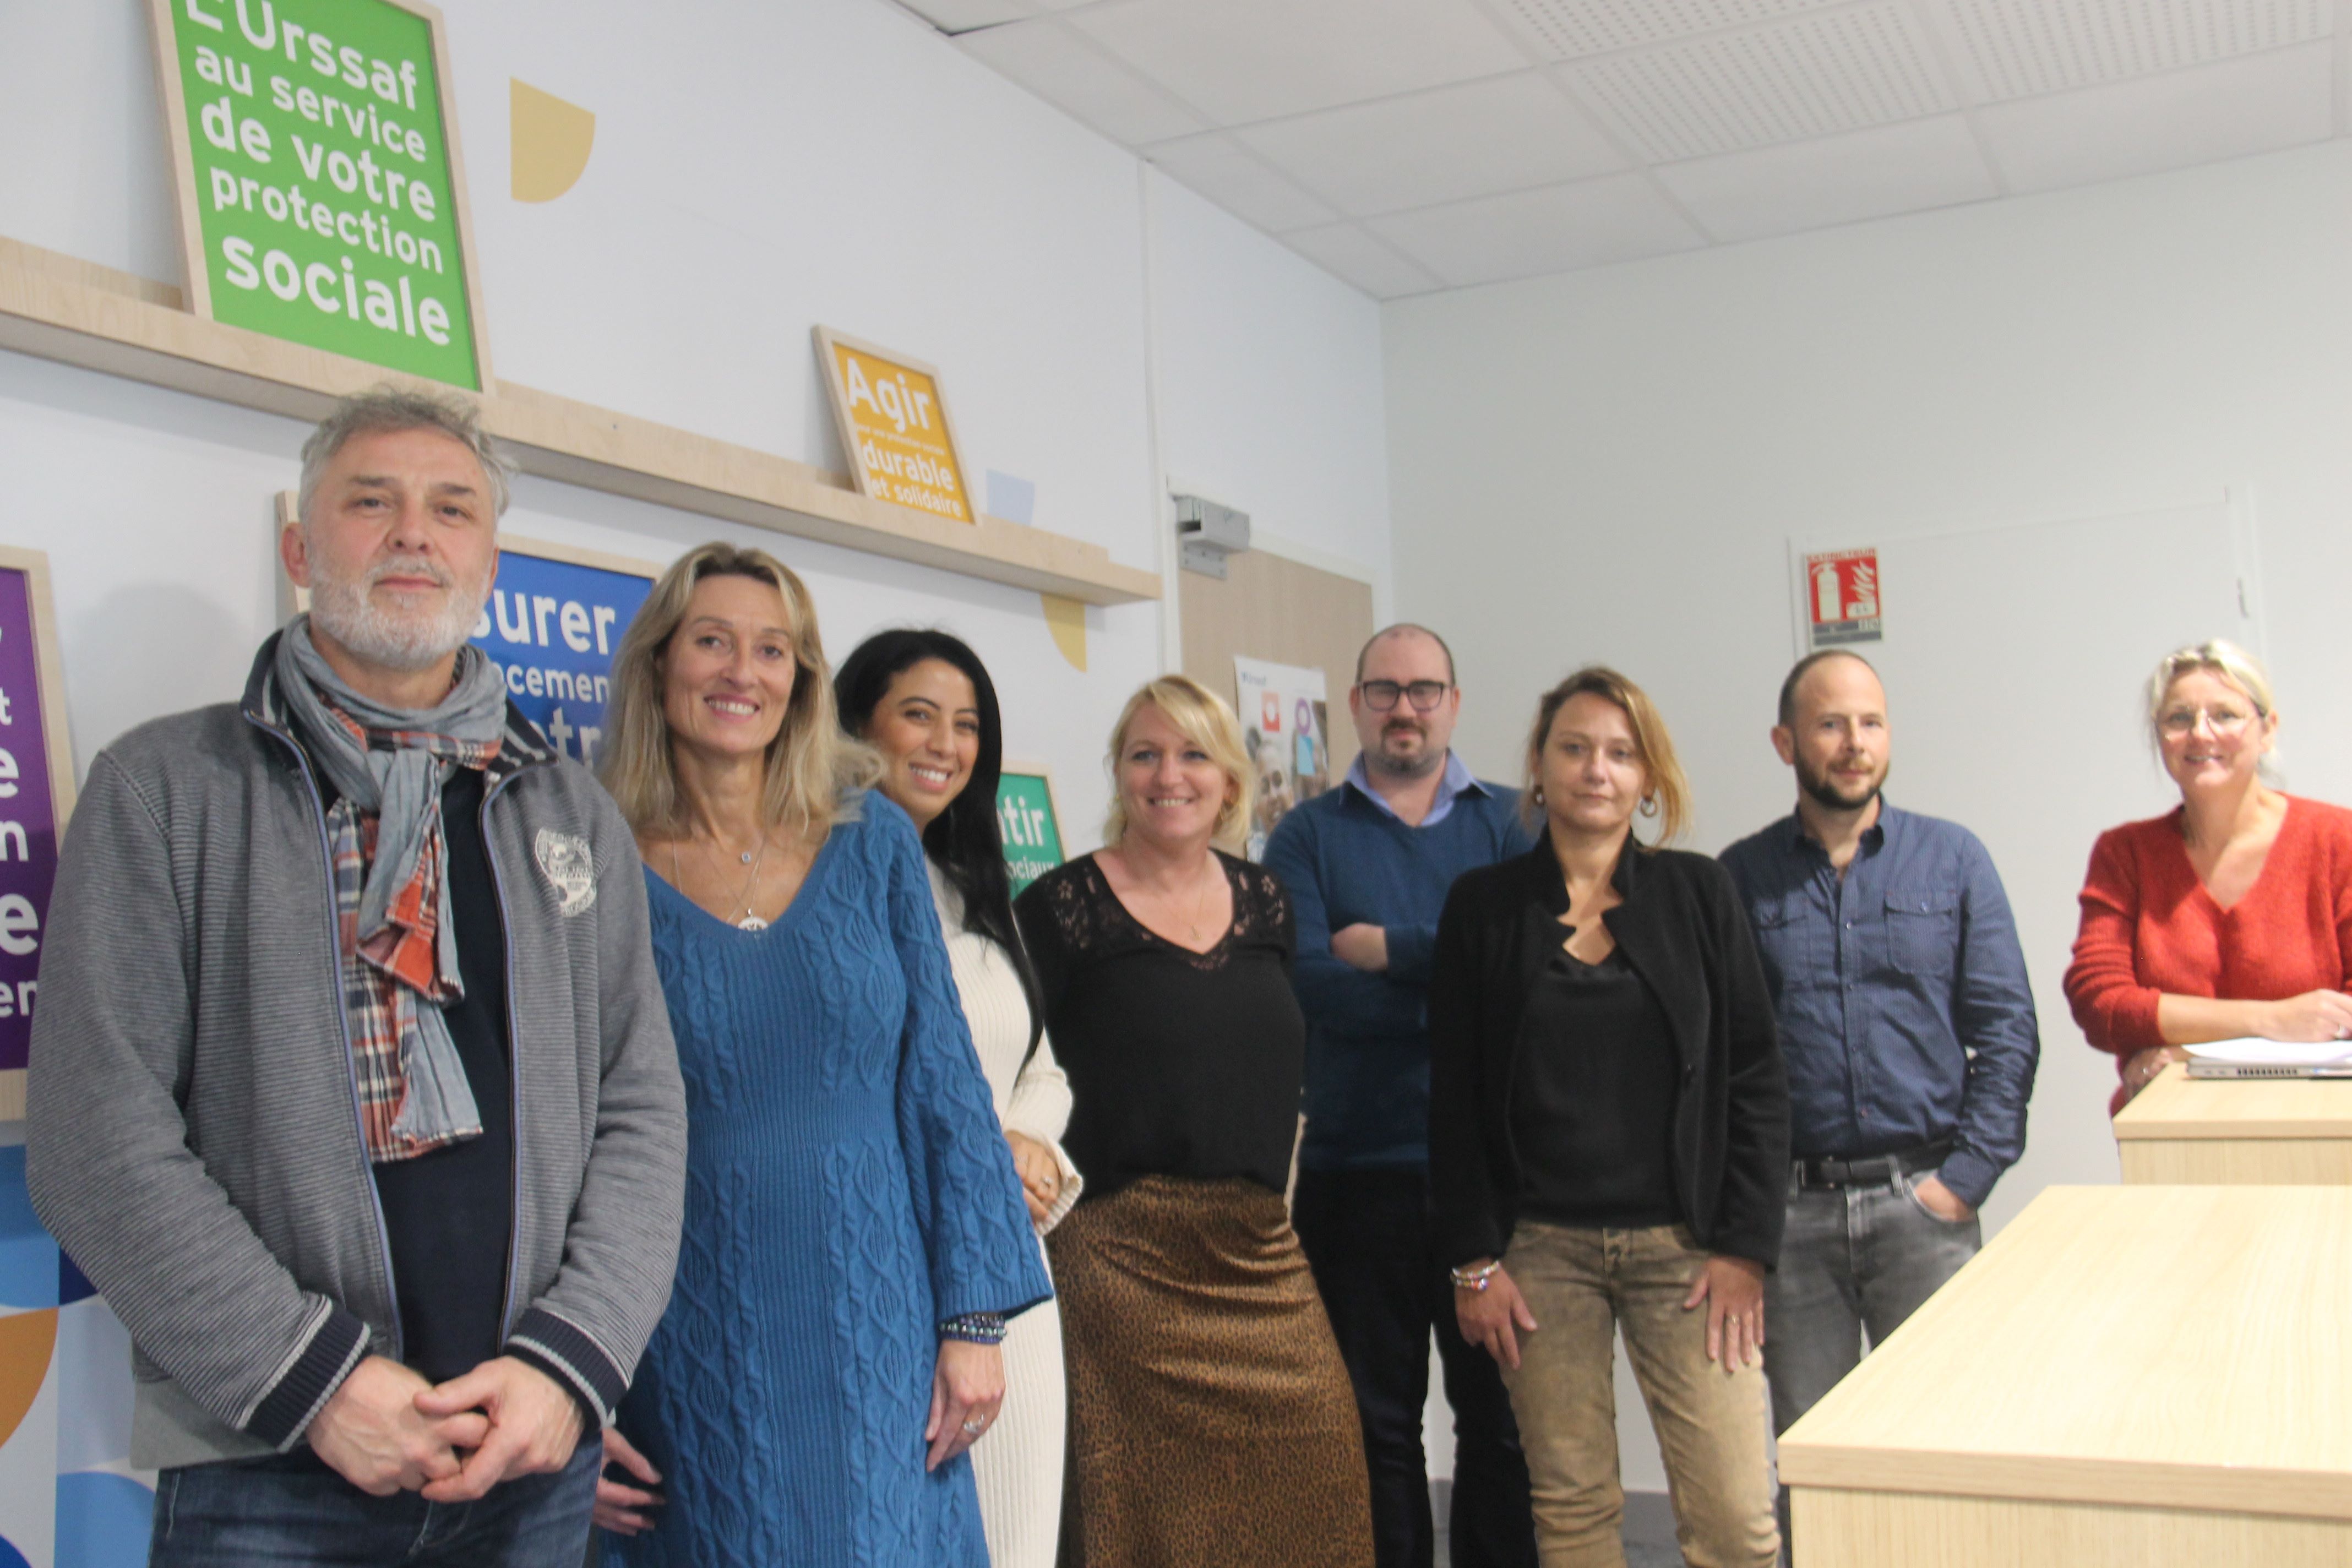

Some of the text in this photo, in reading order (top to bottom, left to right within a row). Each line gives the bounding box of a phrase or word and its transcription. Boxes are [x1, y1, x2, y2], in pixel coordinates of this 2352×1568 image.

[186, 0, 416, 110] LUrssaf
[195, 45, 426, 162] au service
[200, 97, 436, 221] de votre
[210, 167, 444, 274] protection
[222, 236, 450, 346] sociale
[847, 357, 930, 433] Agir
[862, 441, 954, 491] durable
[872, 477, 962, 518] et solidaire
[496, 662, 611, 704] cemen
[997, 796, 1044, 846] tir
